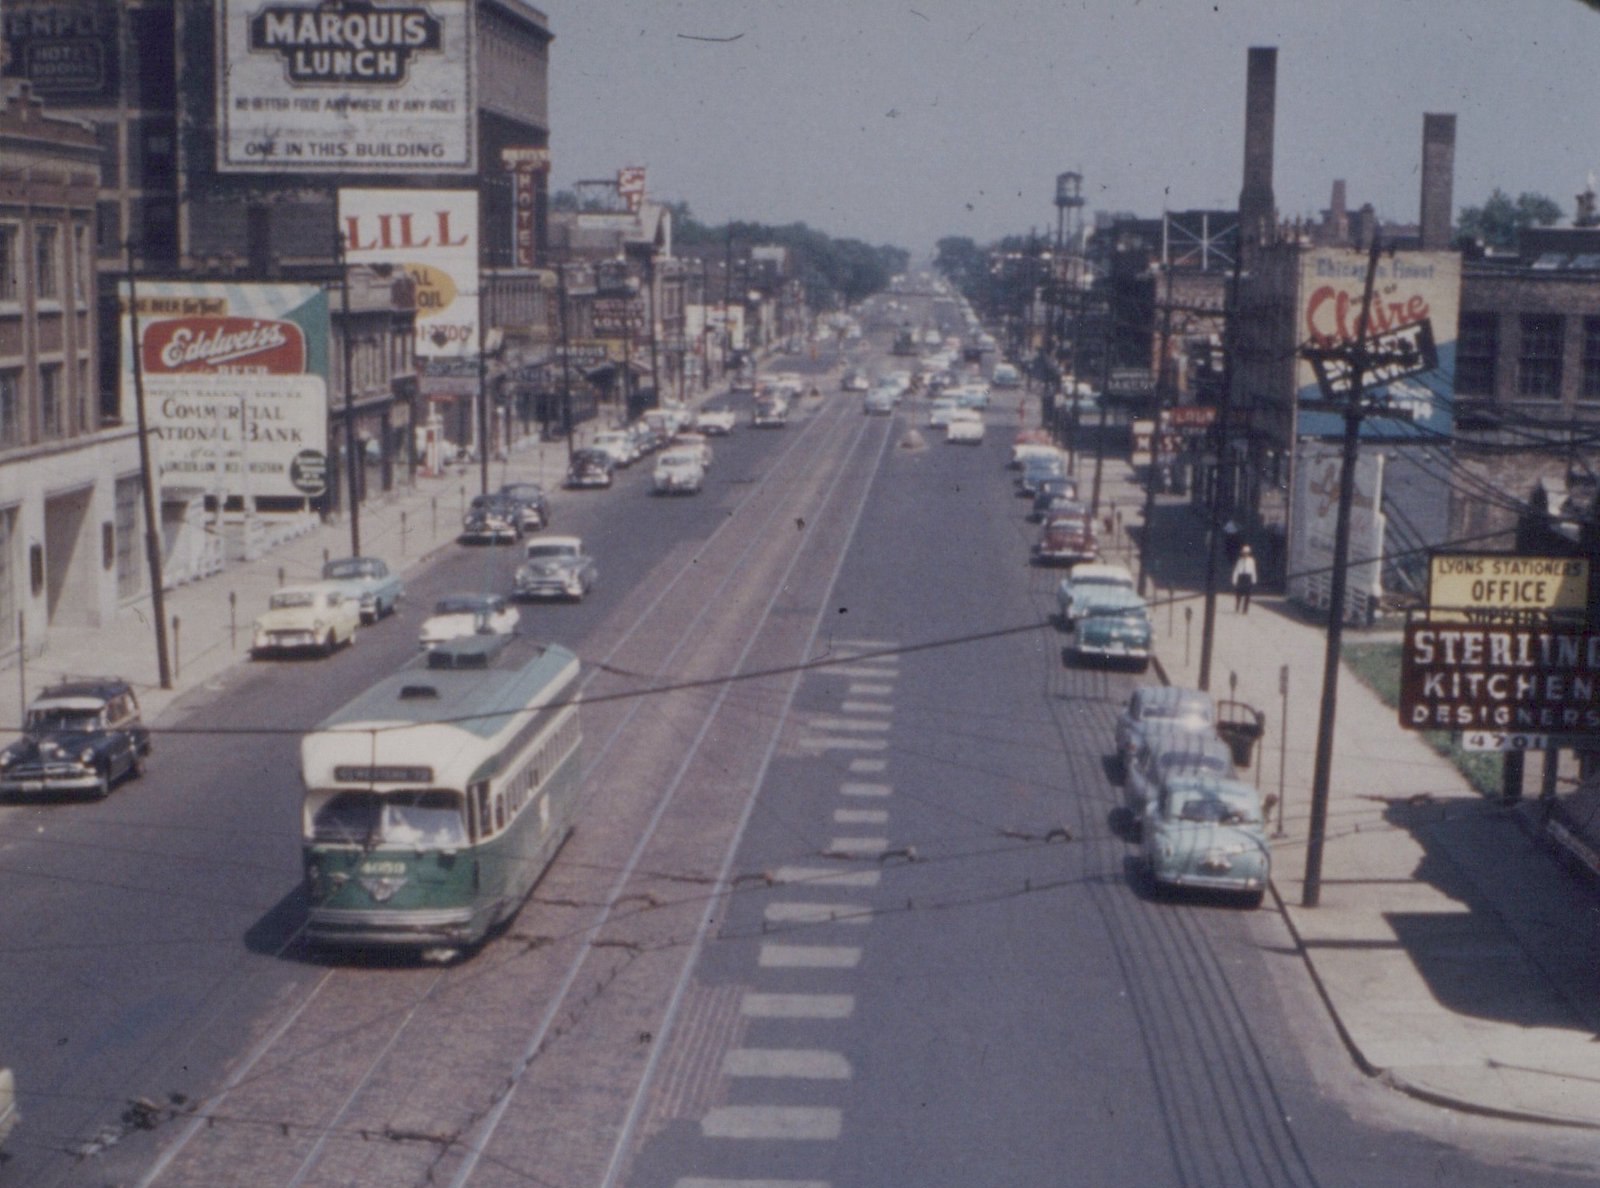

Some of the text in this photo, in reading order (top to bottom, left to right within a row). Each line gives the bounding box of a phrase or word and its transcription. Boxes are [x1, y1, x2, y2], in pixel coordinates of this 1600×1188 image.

[265, 12, 426, 48] MARQUIS
[296, 51, 397, 75] LUNCH
[294, 98, 319, 111] FOOD
[403, 99, 425, 111] ANY
[245, 142, 445, 157] ONE IN THIS BUILDING
[519, 173, 532, 264] HOTEL
[345, 210, 469, 250] LILL
[417, 290, 443, 308] OIL
[161, 321, 287, 368] Edelweiss
[248, 423, 303, 442] BANK
[1439, 559, 1583, 577] LYONS STATIONERS
[1472, 580, 1547, 602] OFFICE
[1424, 671, 1593, 700] KITCHEN
[1412, 705, 1600, 727] DESIGNERS
